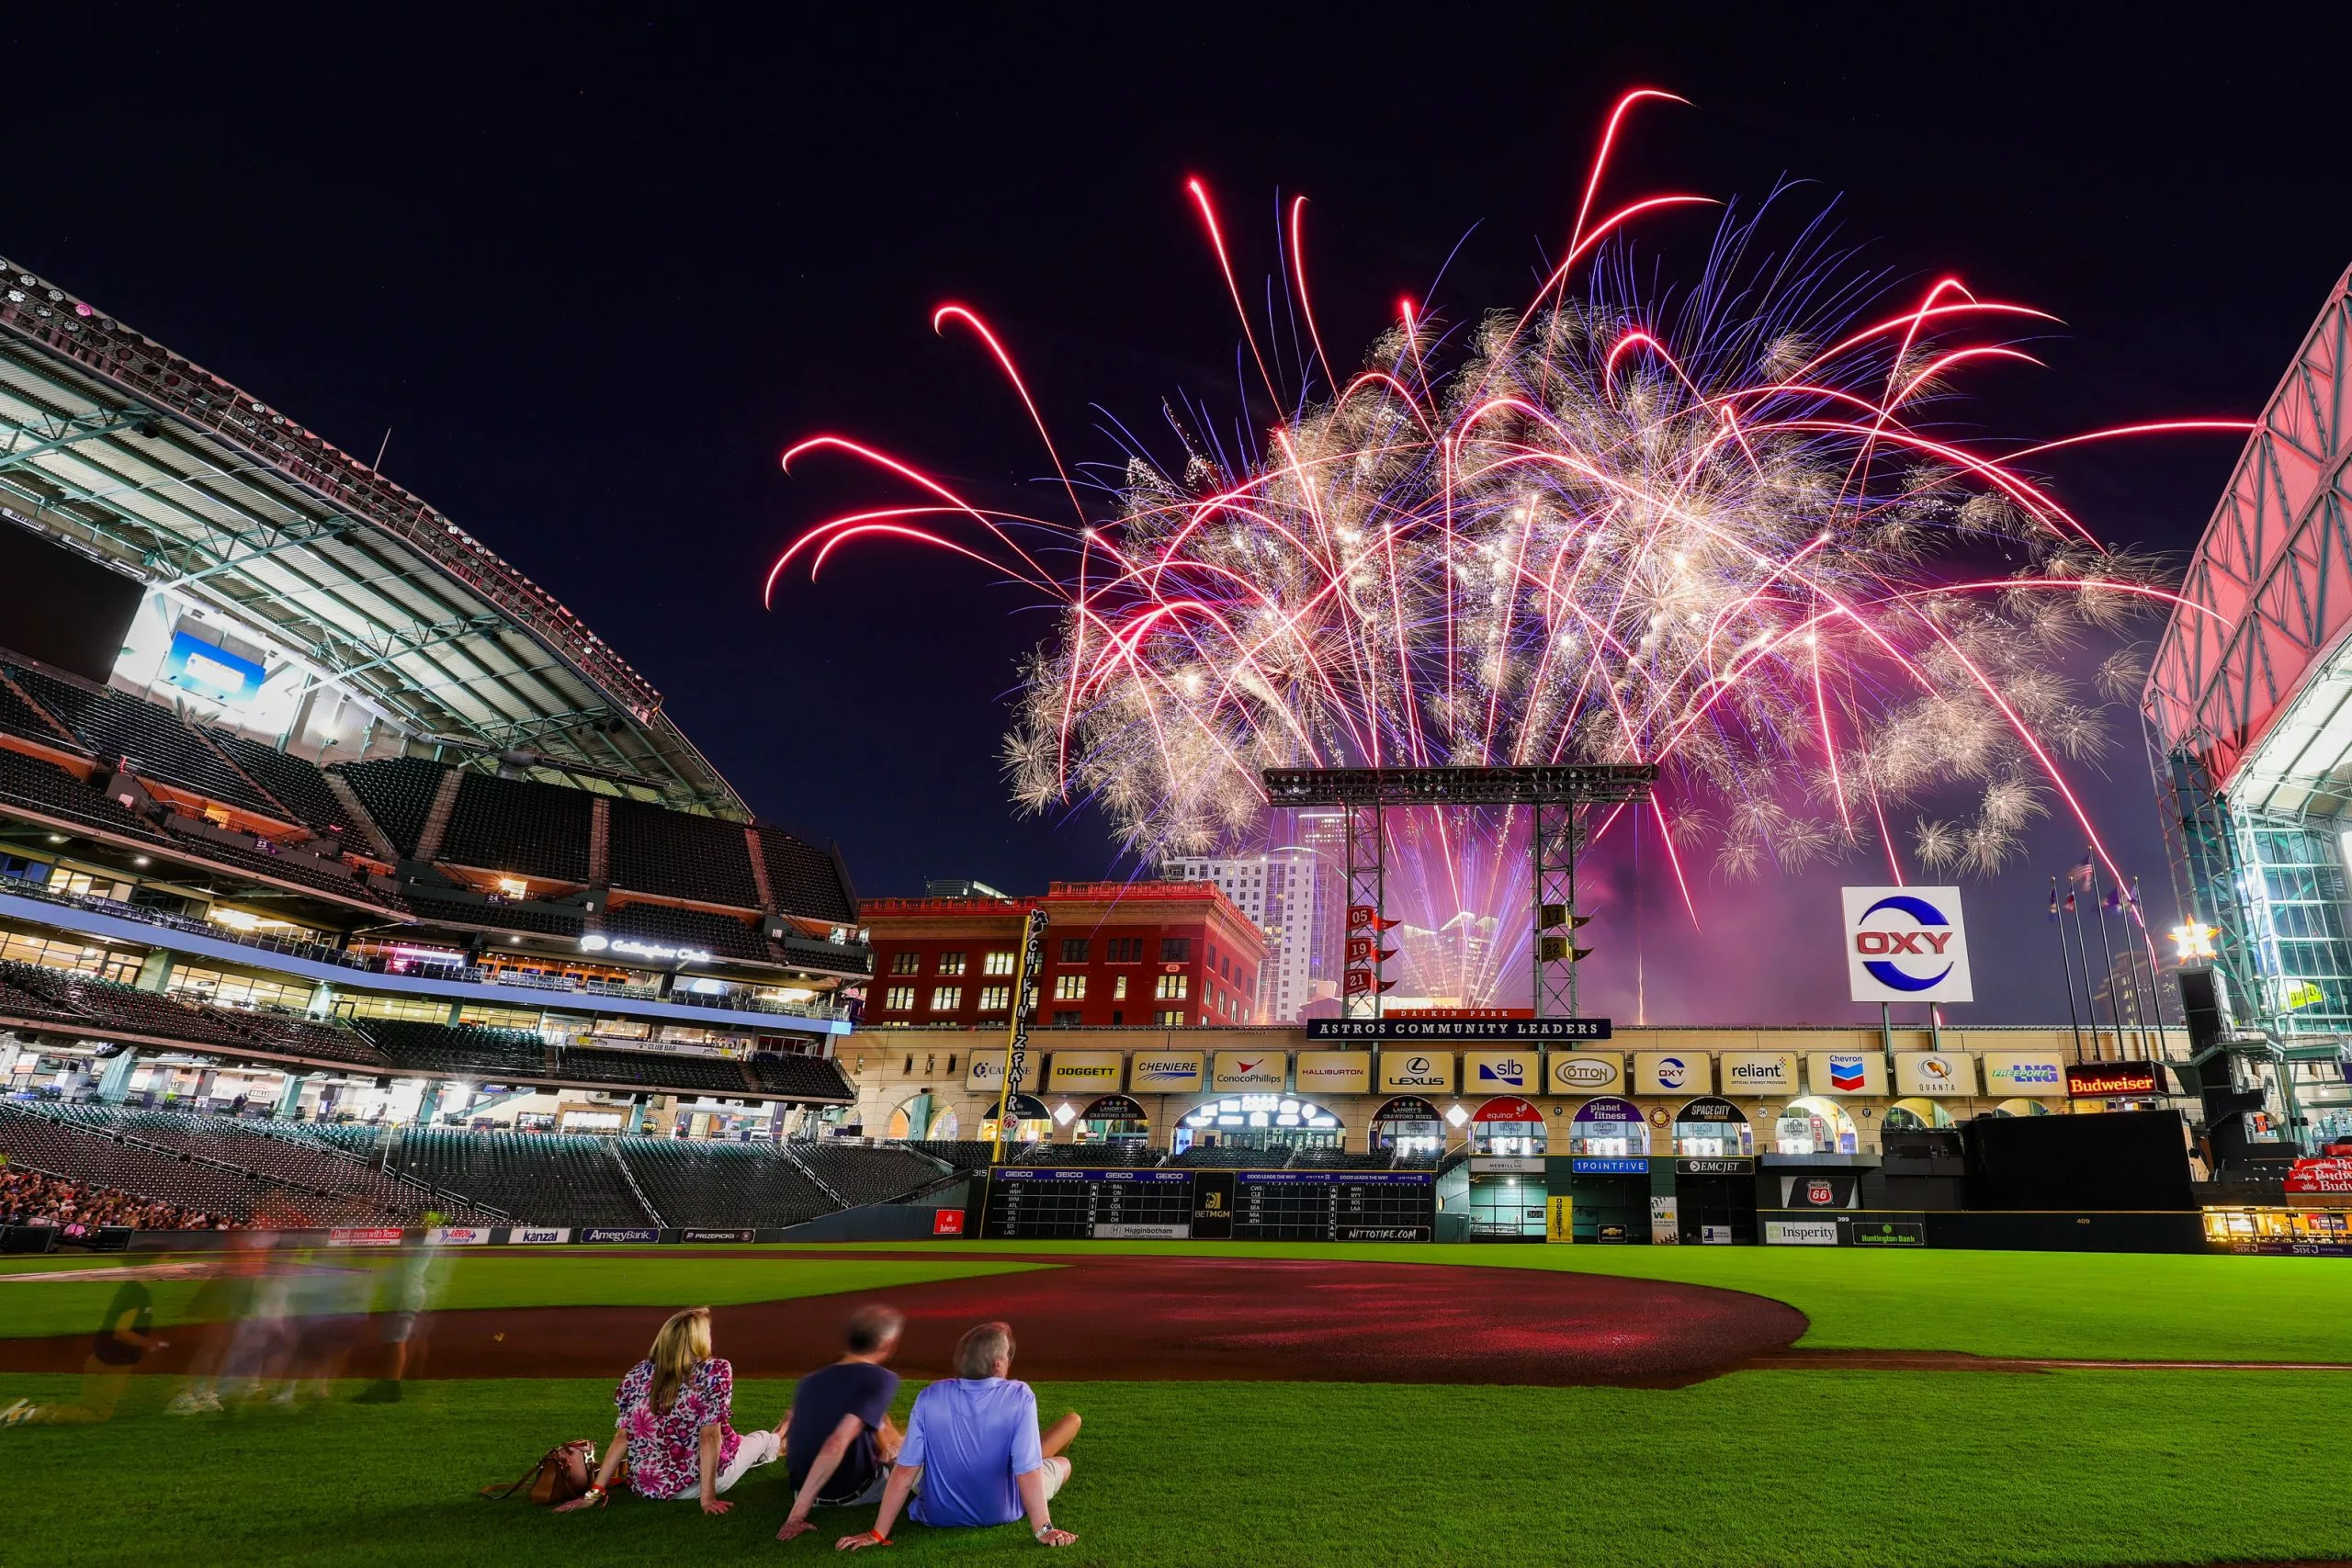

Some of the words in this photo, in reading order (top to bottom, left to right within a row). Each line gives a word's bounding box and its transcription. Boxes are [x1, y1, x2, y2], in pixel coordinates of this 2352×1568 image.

[1352, 910, 1367, 923] 05
[1546, 910, 1560, 921] 17
[1857, 932, 1953, 954] OXY
[1352, 943, 1366, 955] 19
[1545, 944, 1560, 954] 22
[1350, 974, 1364, 986] 21
[1319, 1024, 1385, 1034] ASTROS
[1396, 1024, 1508, 1034] COMMUNITY
[1518, 1024, 1598, 1034] LEADERS
[1139, 1062, 1198, 1071] CHENIERE
[1497, 1059, 1523, 1075] slb
[1732, 1064, 1781, 1077] reliant
[1563, 1065, 1607, 1081] COTTON
[2013, 1065, 2058, 1082] LNG
[1217, 1074, 1281, 1084] ConocoPhillips
[2070, 1077, 2153, 1092] Budweiser
[1590, 1103, 1620, 1113] planet
[1692, 1105, 1713, 1115] SPACE
[1714, 1105, 1730, 1115] CITY
[1594, 1111, 1626, 1120] fitness
[1701, 1162, 1739, 1172] EMCJET
[1813, 1190, 1827, 1199] 66
[1088, 1185, 1096, 1235] NATIONAL
[369, 1230, 381, 1239] with
[382, 1230, 399, 1238] Texas
[590, 1230, 649, 1241] AmegyBank
[1349, 1229, 1416, 1239] NITTOTIRE.COM
[1783, 1227, 1834, 1239] Insperity
